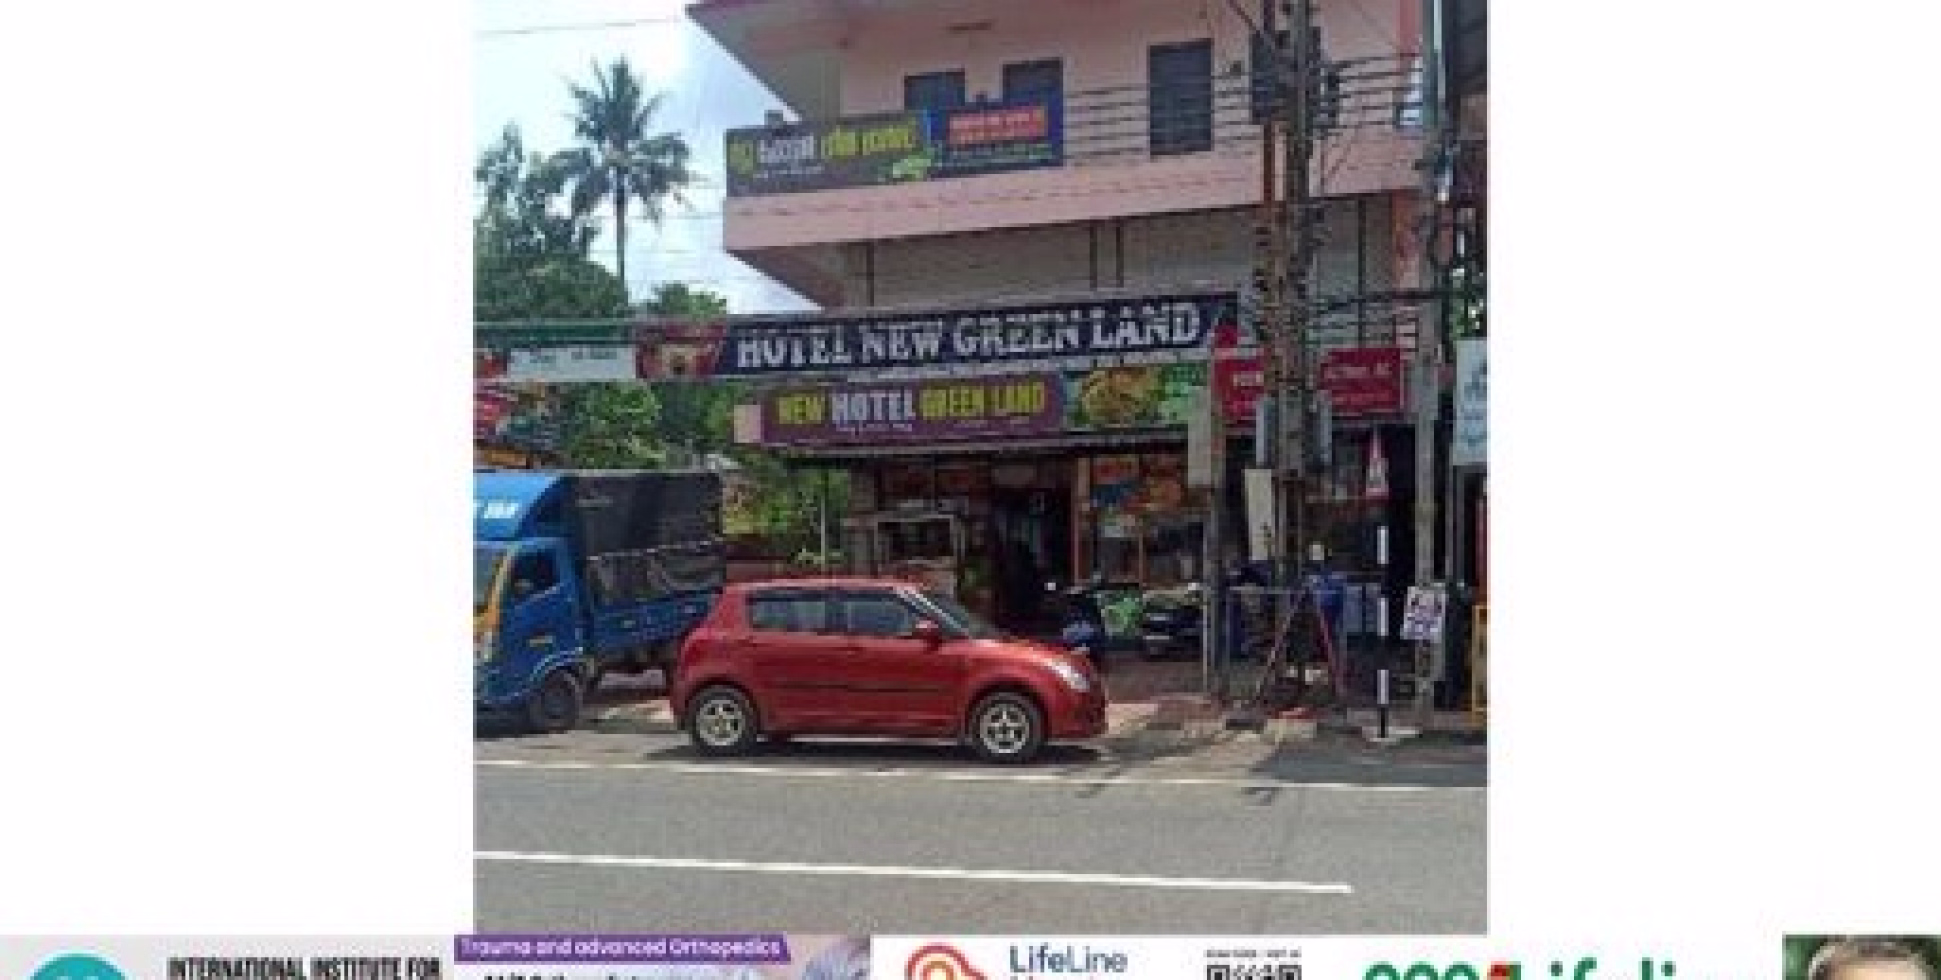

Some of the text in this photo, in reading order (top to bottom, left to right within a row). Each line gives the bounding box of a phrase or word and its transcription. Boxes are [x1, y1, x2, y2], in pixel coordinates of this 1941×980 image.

[737, 301, 1201, 368] HOTEL NEW GREEN LAND
[778, 380, 1046, 425] NEW HOTEL GREEN LAND
